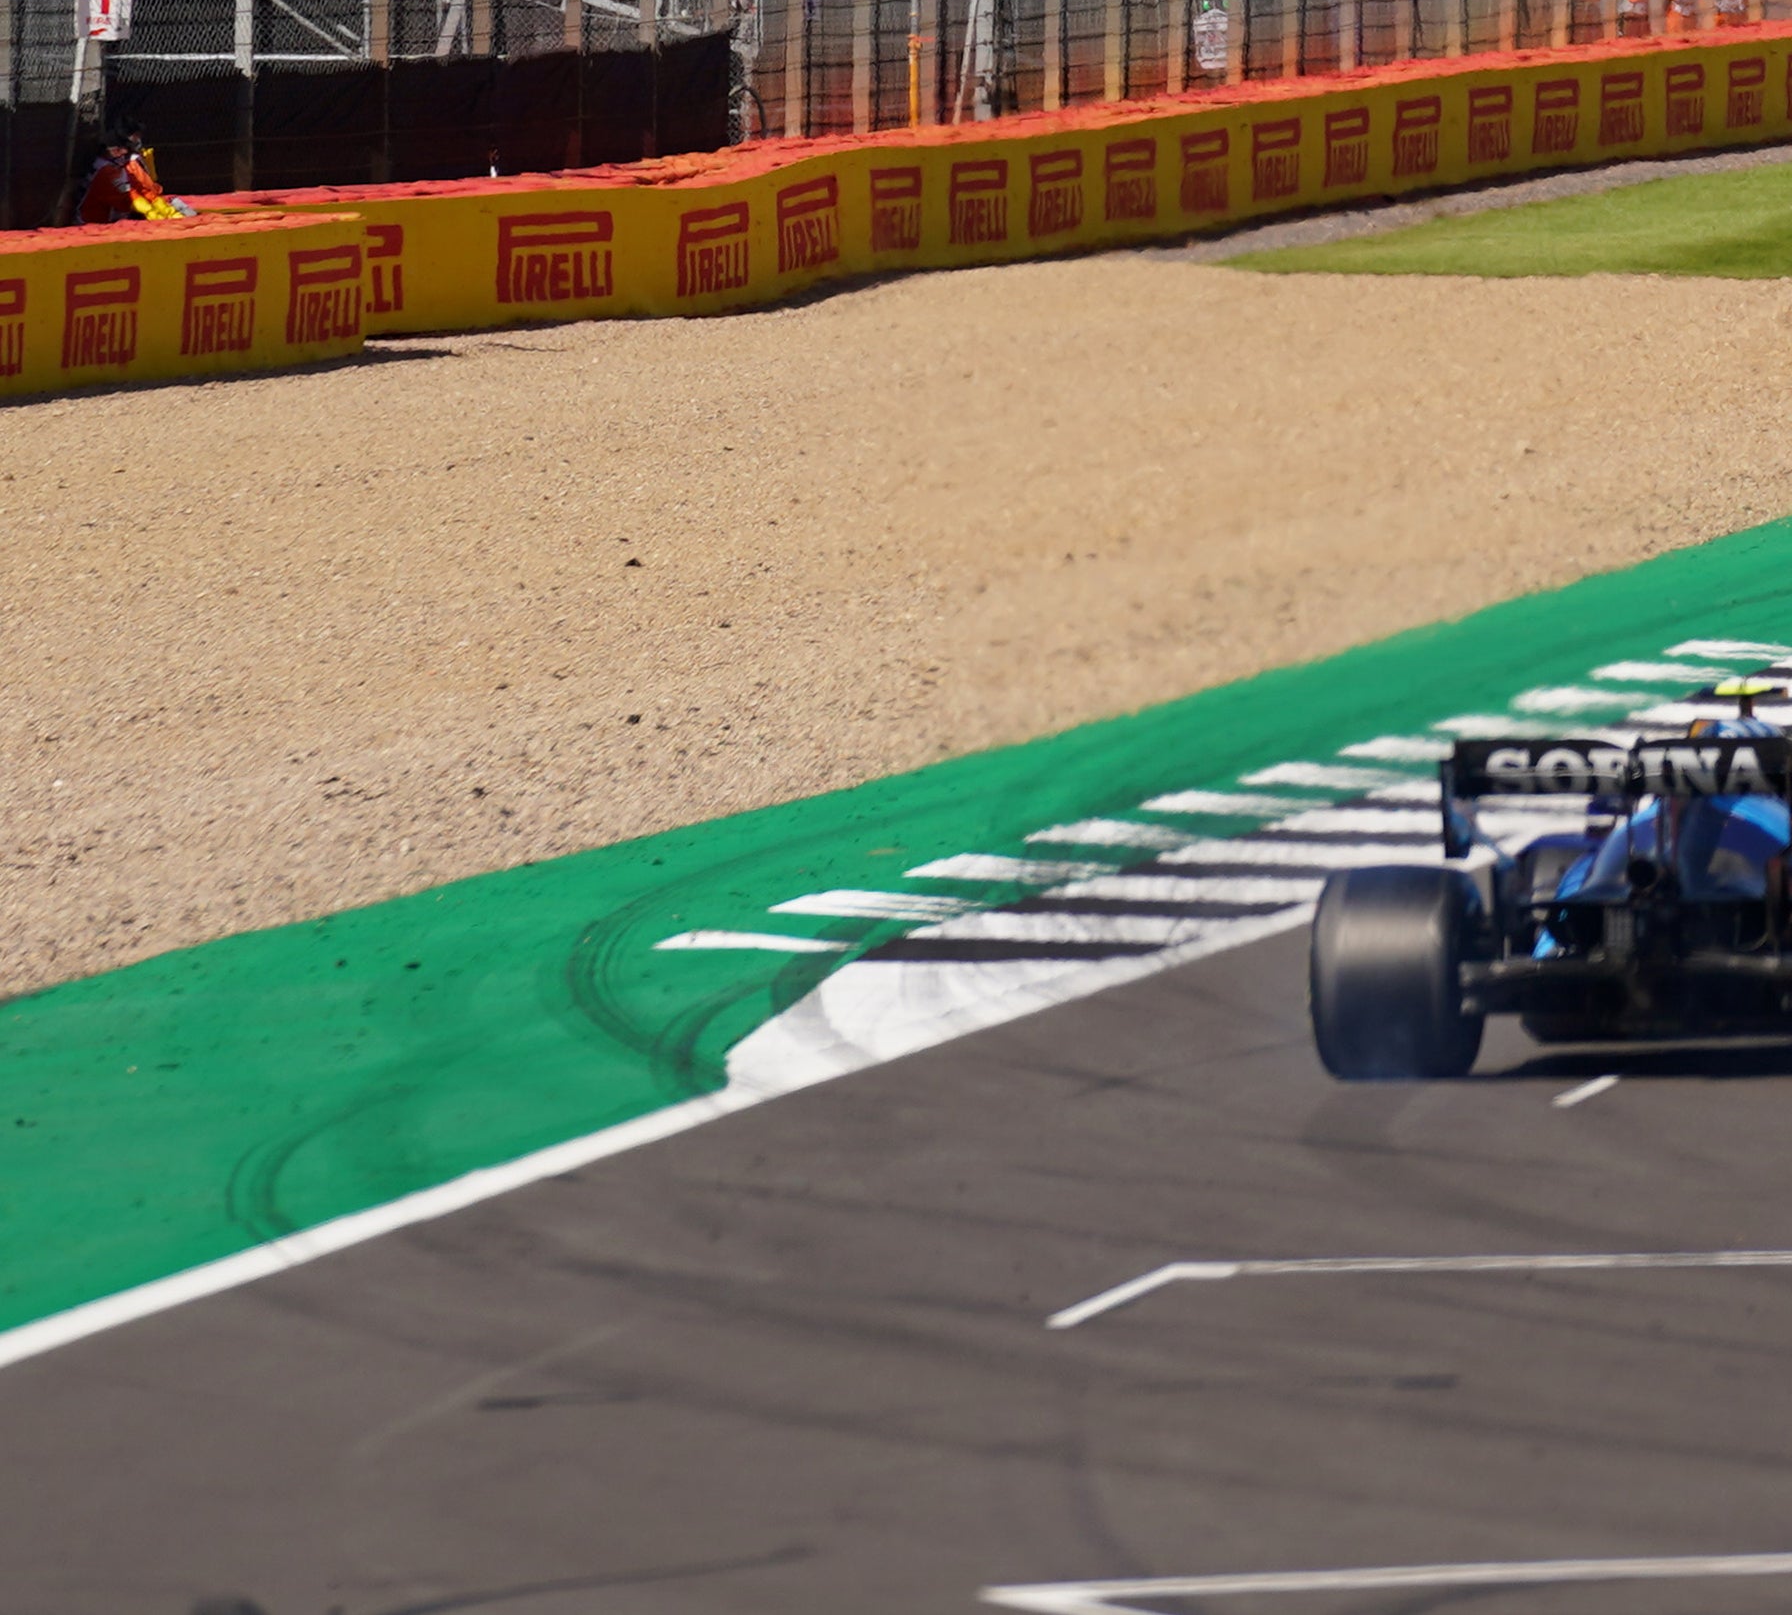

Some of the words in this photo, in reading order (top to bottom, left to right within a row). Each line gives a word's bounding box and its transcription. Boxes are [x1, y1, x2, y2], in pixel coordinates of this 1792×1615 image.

[777, 174, 840, 275] PIRELLI
[870, 166, 922, 253] PIRELLI
[948, 158, 1009, 246] PIRELLI
[1028, 148, 1084, 239] PIRELLI
[286, 244, 363, 344] PIRELLI
[497, 210, 614, 304] PIRELLI
[676, 201, 750, 298] PIRELLI
[61, 266, 141, 369] PIRELLI
[180, 257, 259, 356] PIRELLI
